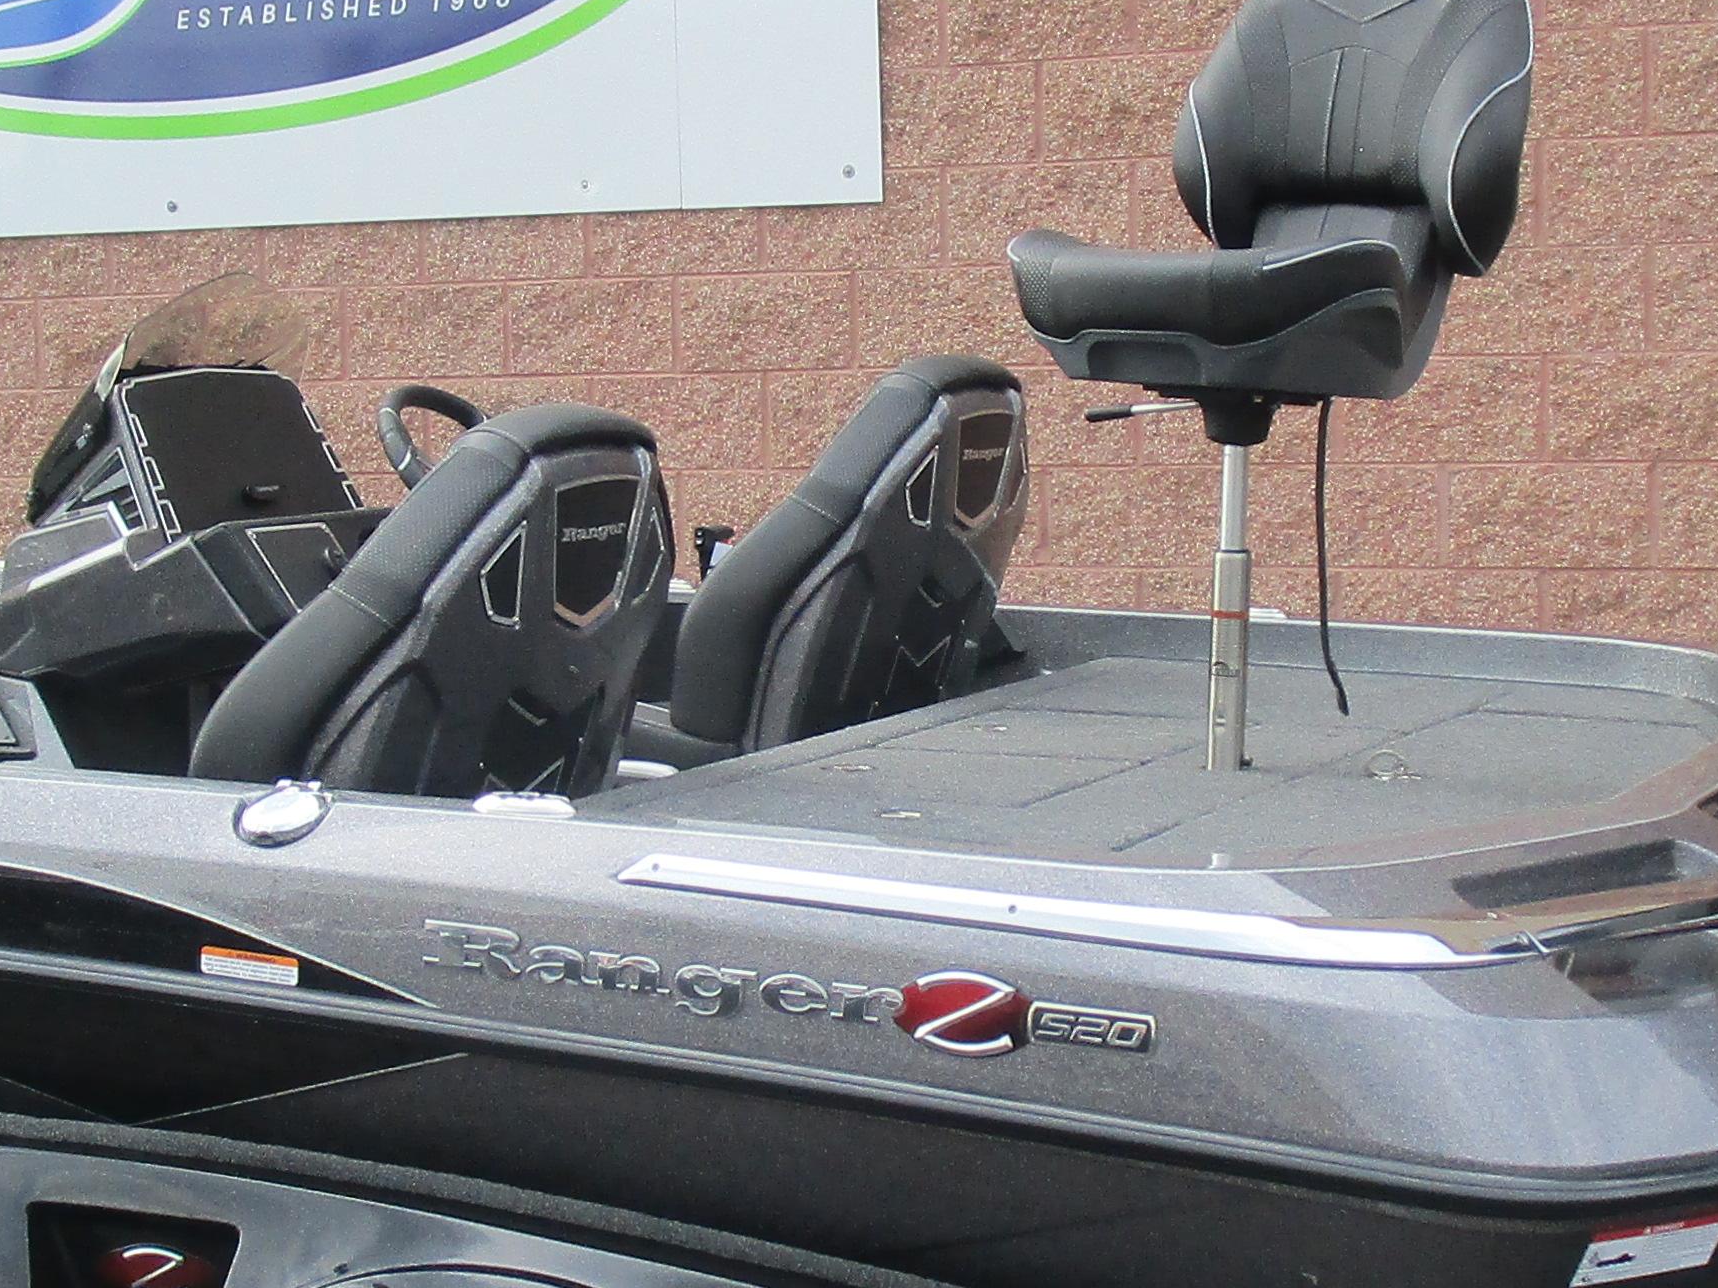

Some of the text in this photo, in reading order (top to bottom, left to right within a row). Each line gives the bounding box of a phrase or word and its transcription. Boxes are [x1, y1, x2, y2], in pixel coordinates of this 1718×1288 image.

[561, 522, 627, 542] Ranger
[421, 918, 905, 1023] Ranger
[1033, 1009, 1150, 1049] 520
